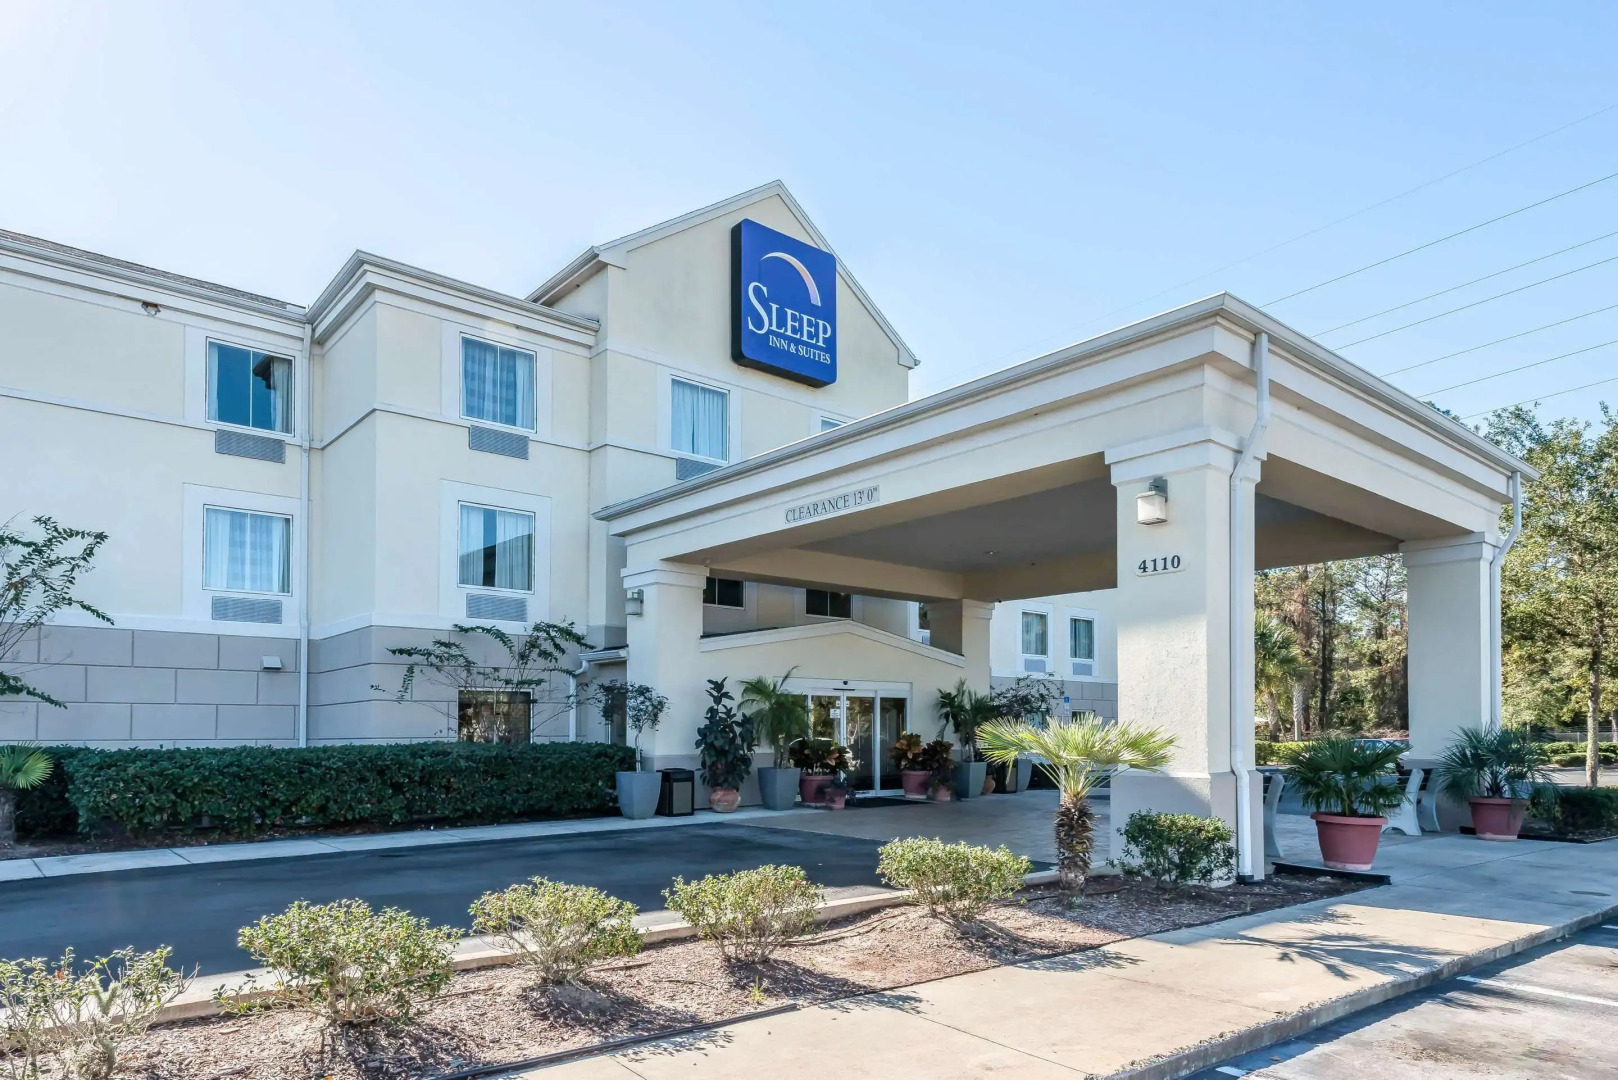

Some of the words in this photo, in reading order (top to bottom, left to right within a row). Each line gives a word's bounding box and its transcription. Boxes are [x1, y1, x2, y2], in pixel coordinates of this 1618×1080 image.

[748, 282, 832, 347] SLEEP
[769, 335, 788, 350] INN
[789, 343, 797, 354] &
[798, 344, 831, 364] SUITES
[785, 494, 850, 523] CLEARANCE
[1138, 555, 1181, 573] 4110
